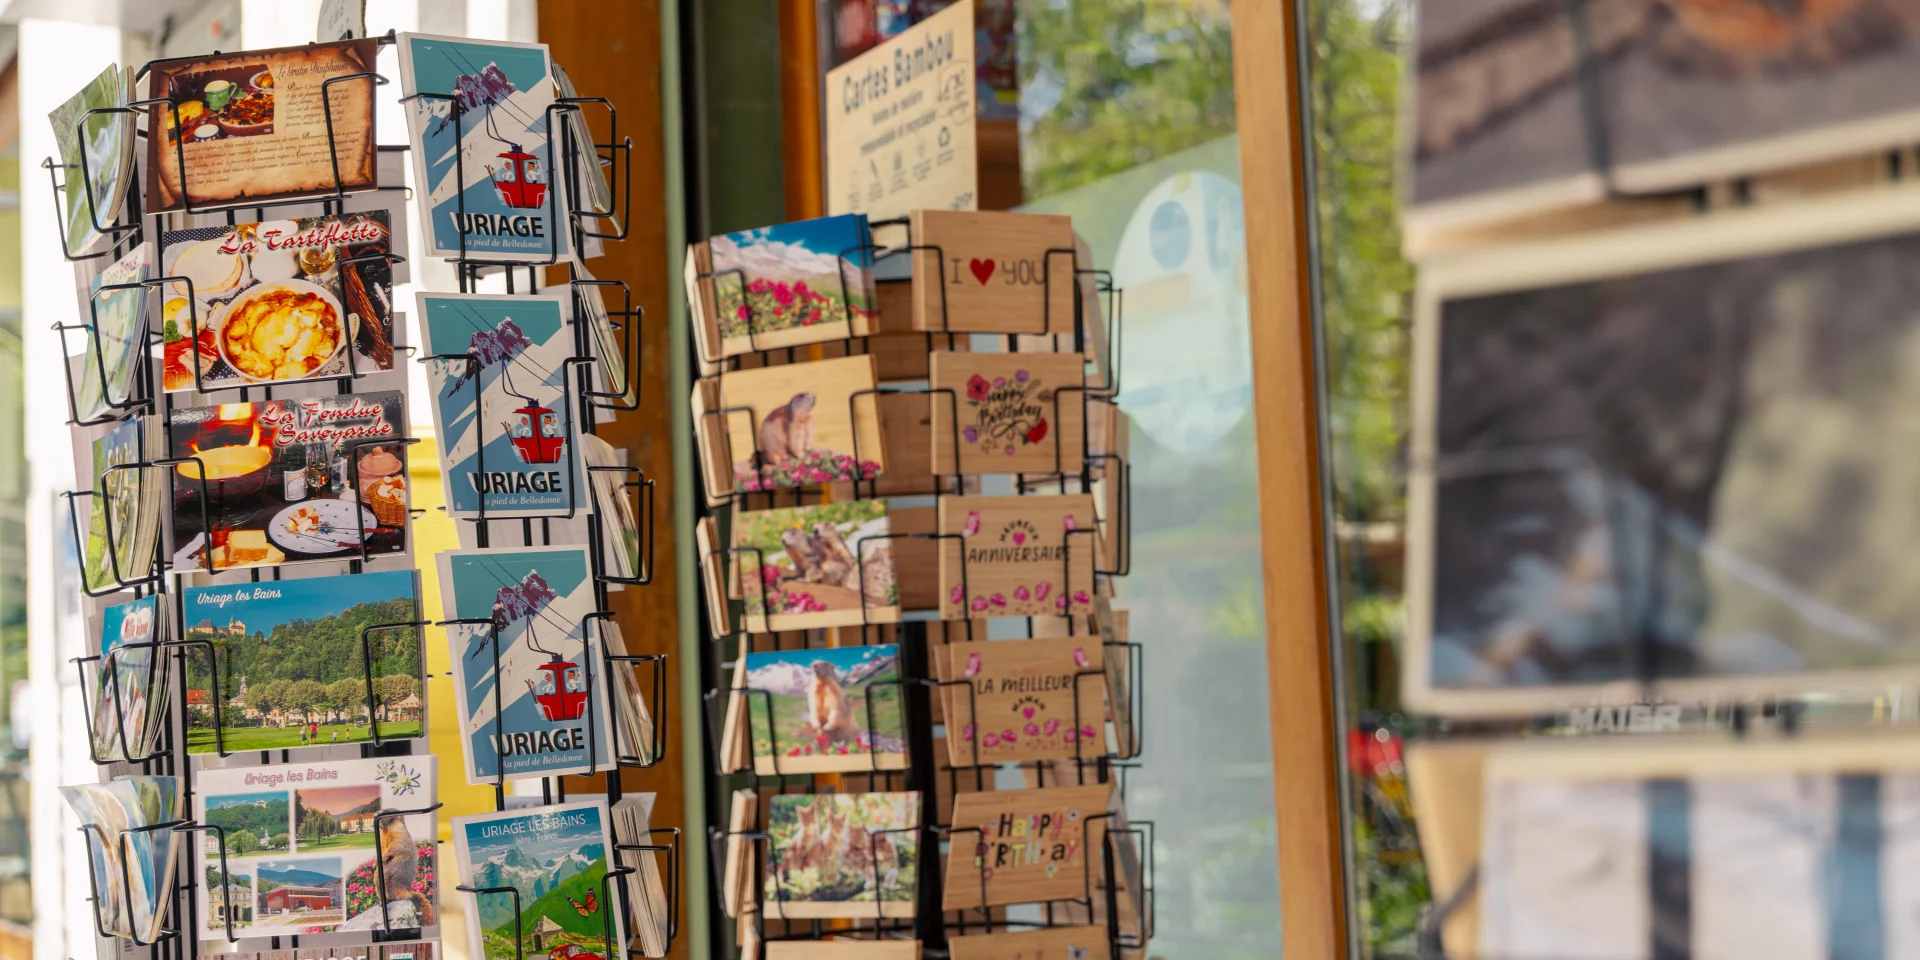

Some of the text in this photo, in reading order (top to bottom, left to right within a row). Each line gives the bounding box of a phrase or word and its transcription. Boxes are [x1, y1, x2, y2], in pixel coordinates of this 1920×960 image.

[842, 66, 888, 114] Cartes
[894, 30, 954, 88] Bambou
[454, 212, 544, 238] URIAGE
[219, 223, 380, 254] La Tartiflette
[473, 239, 490, 249] pied
[502, 240, 543, 248] Belledonne
[261, 398, 382, 424] La Fondue
[276, 416, 392, 446] Savoyarde
[471, 471, 562, 494] URIAGE
[492, 496, 508, 508] pied
[509, 497, 518, 505] de
[520, 496, 560, 505] Belledonne
[197, 587, 282, 609] Uriage les Bains
[977, 674, 1077, 695] LA MEILLEUR
[492, 728, 585, 758] URIAGE
[514, 758, 530, 770] pied
[531, 756, 541, 766] de
[542, 754, 583, 765] Belledonne
[244, 768, 338, 788] Uriage les Bains
[481, 814, 586, 838] URIAGE LES BAINS
[516, 836, 532, 845] Isère
[536, 832, 558, 843] France
